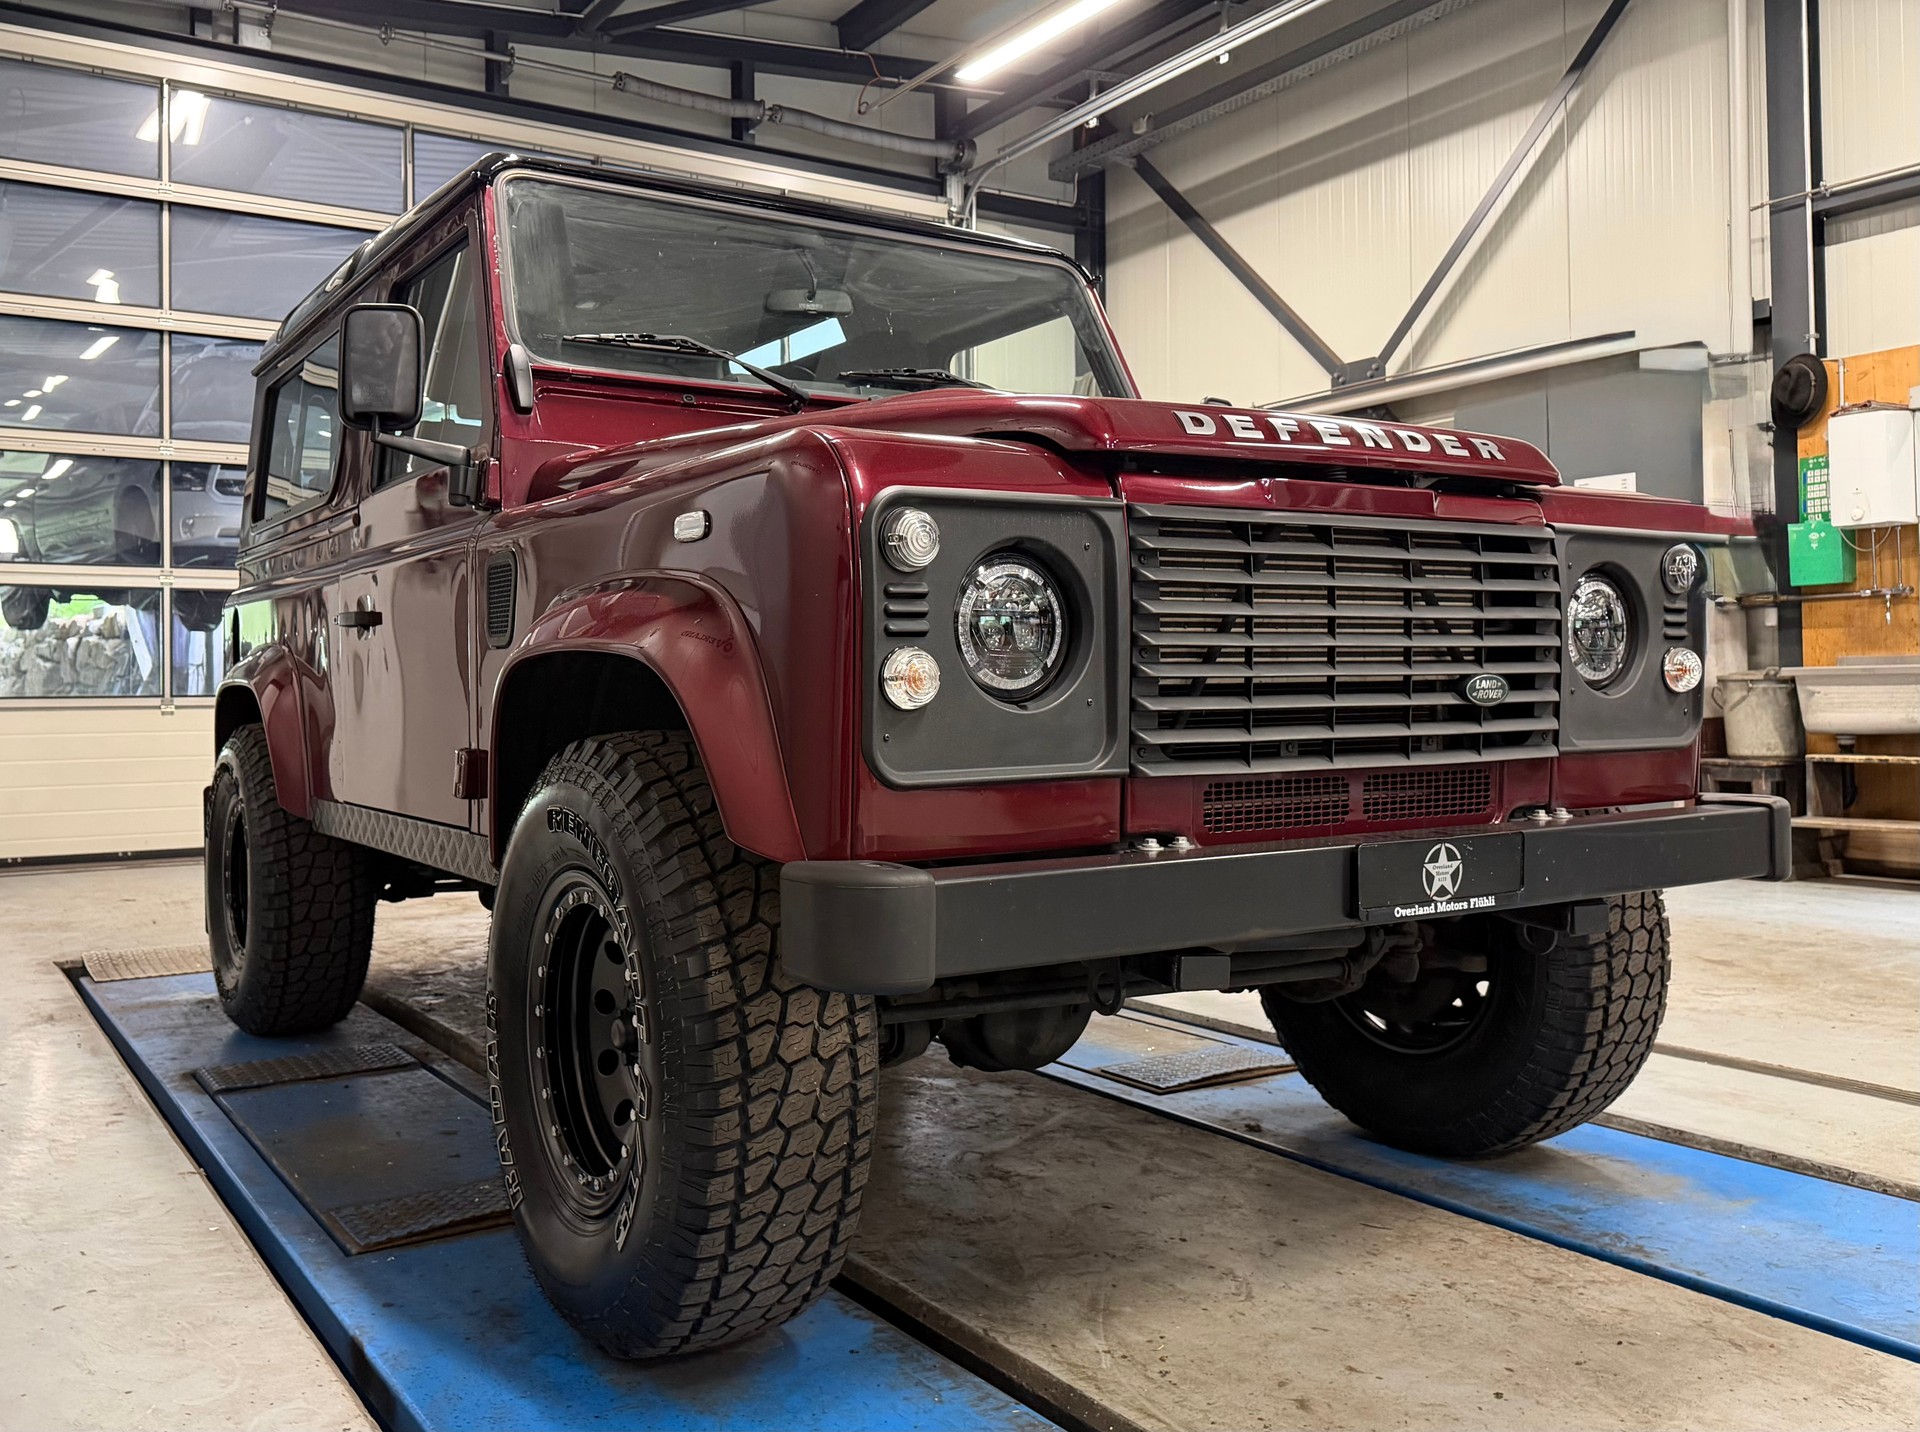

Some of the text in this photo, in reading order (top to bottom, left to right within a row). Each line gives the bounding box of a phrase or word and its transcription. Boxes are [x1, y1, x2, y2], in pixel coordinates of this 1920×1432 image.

[1173, 410, 1506, 461] DEFENDER
[1475, 679, 1497, 689] LAND
[1477, 689, 1503, 699] ROVER
[1394, 896, 1495, 917] Overland Motors Flühli
